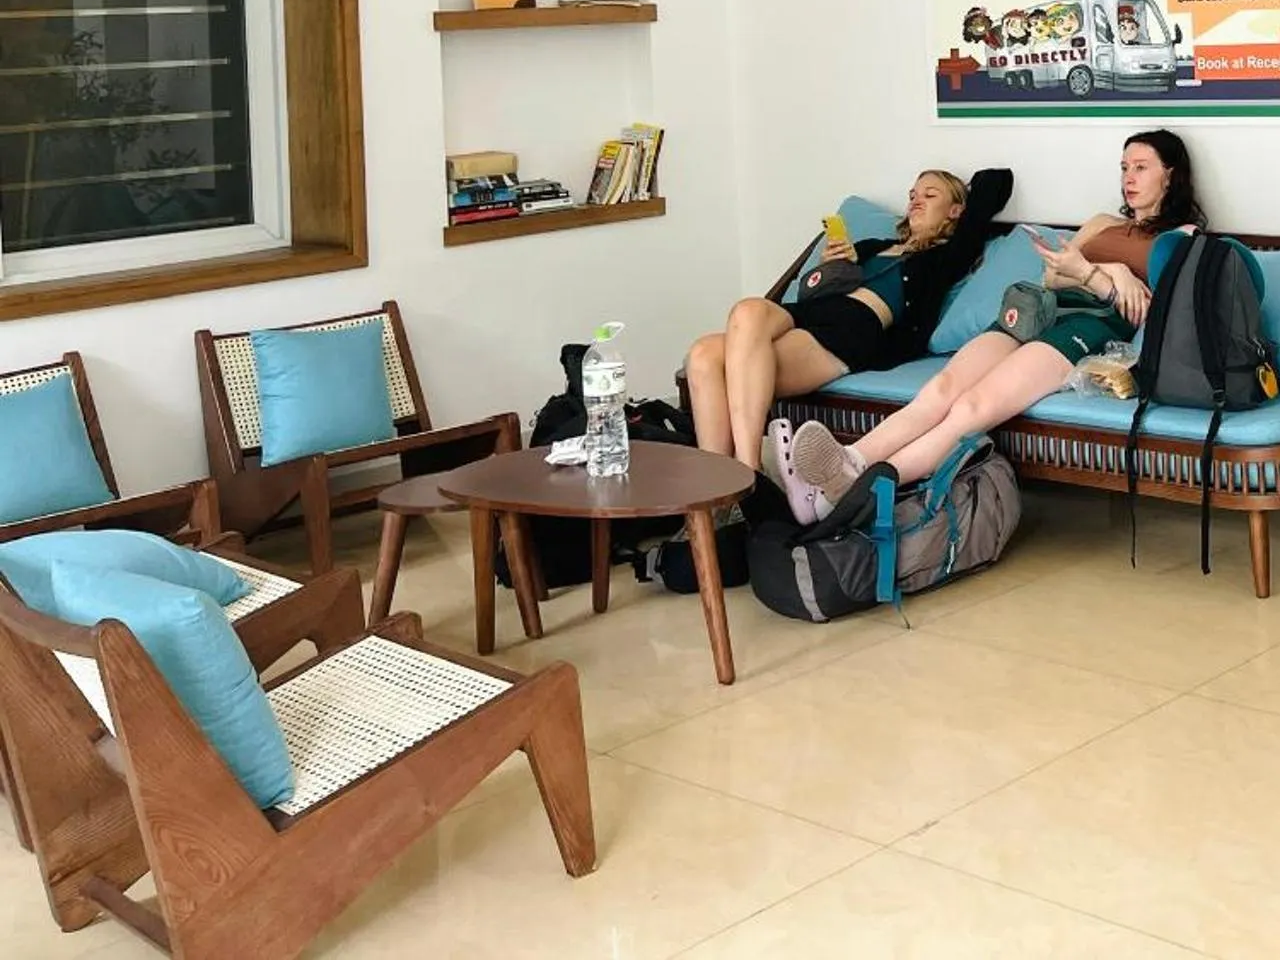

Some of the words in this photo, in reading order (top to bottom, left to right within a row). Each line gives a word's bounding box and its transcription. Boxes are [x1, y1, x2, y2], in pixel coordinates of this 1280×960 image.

[989, 56, 1007, 68] GO
[1015, 49, 1087, 65] DIRECTLY
[1197, 56, 1228, 69] Book
[1232, 56, 1244, 68] at
